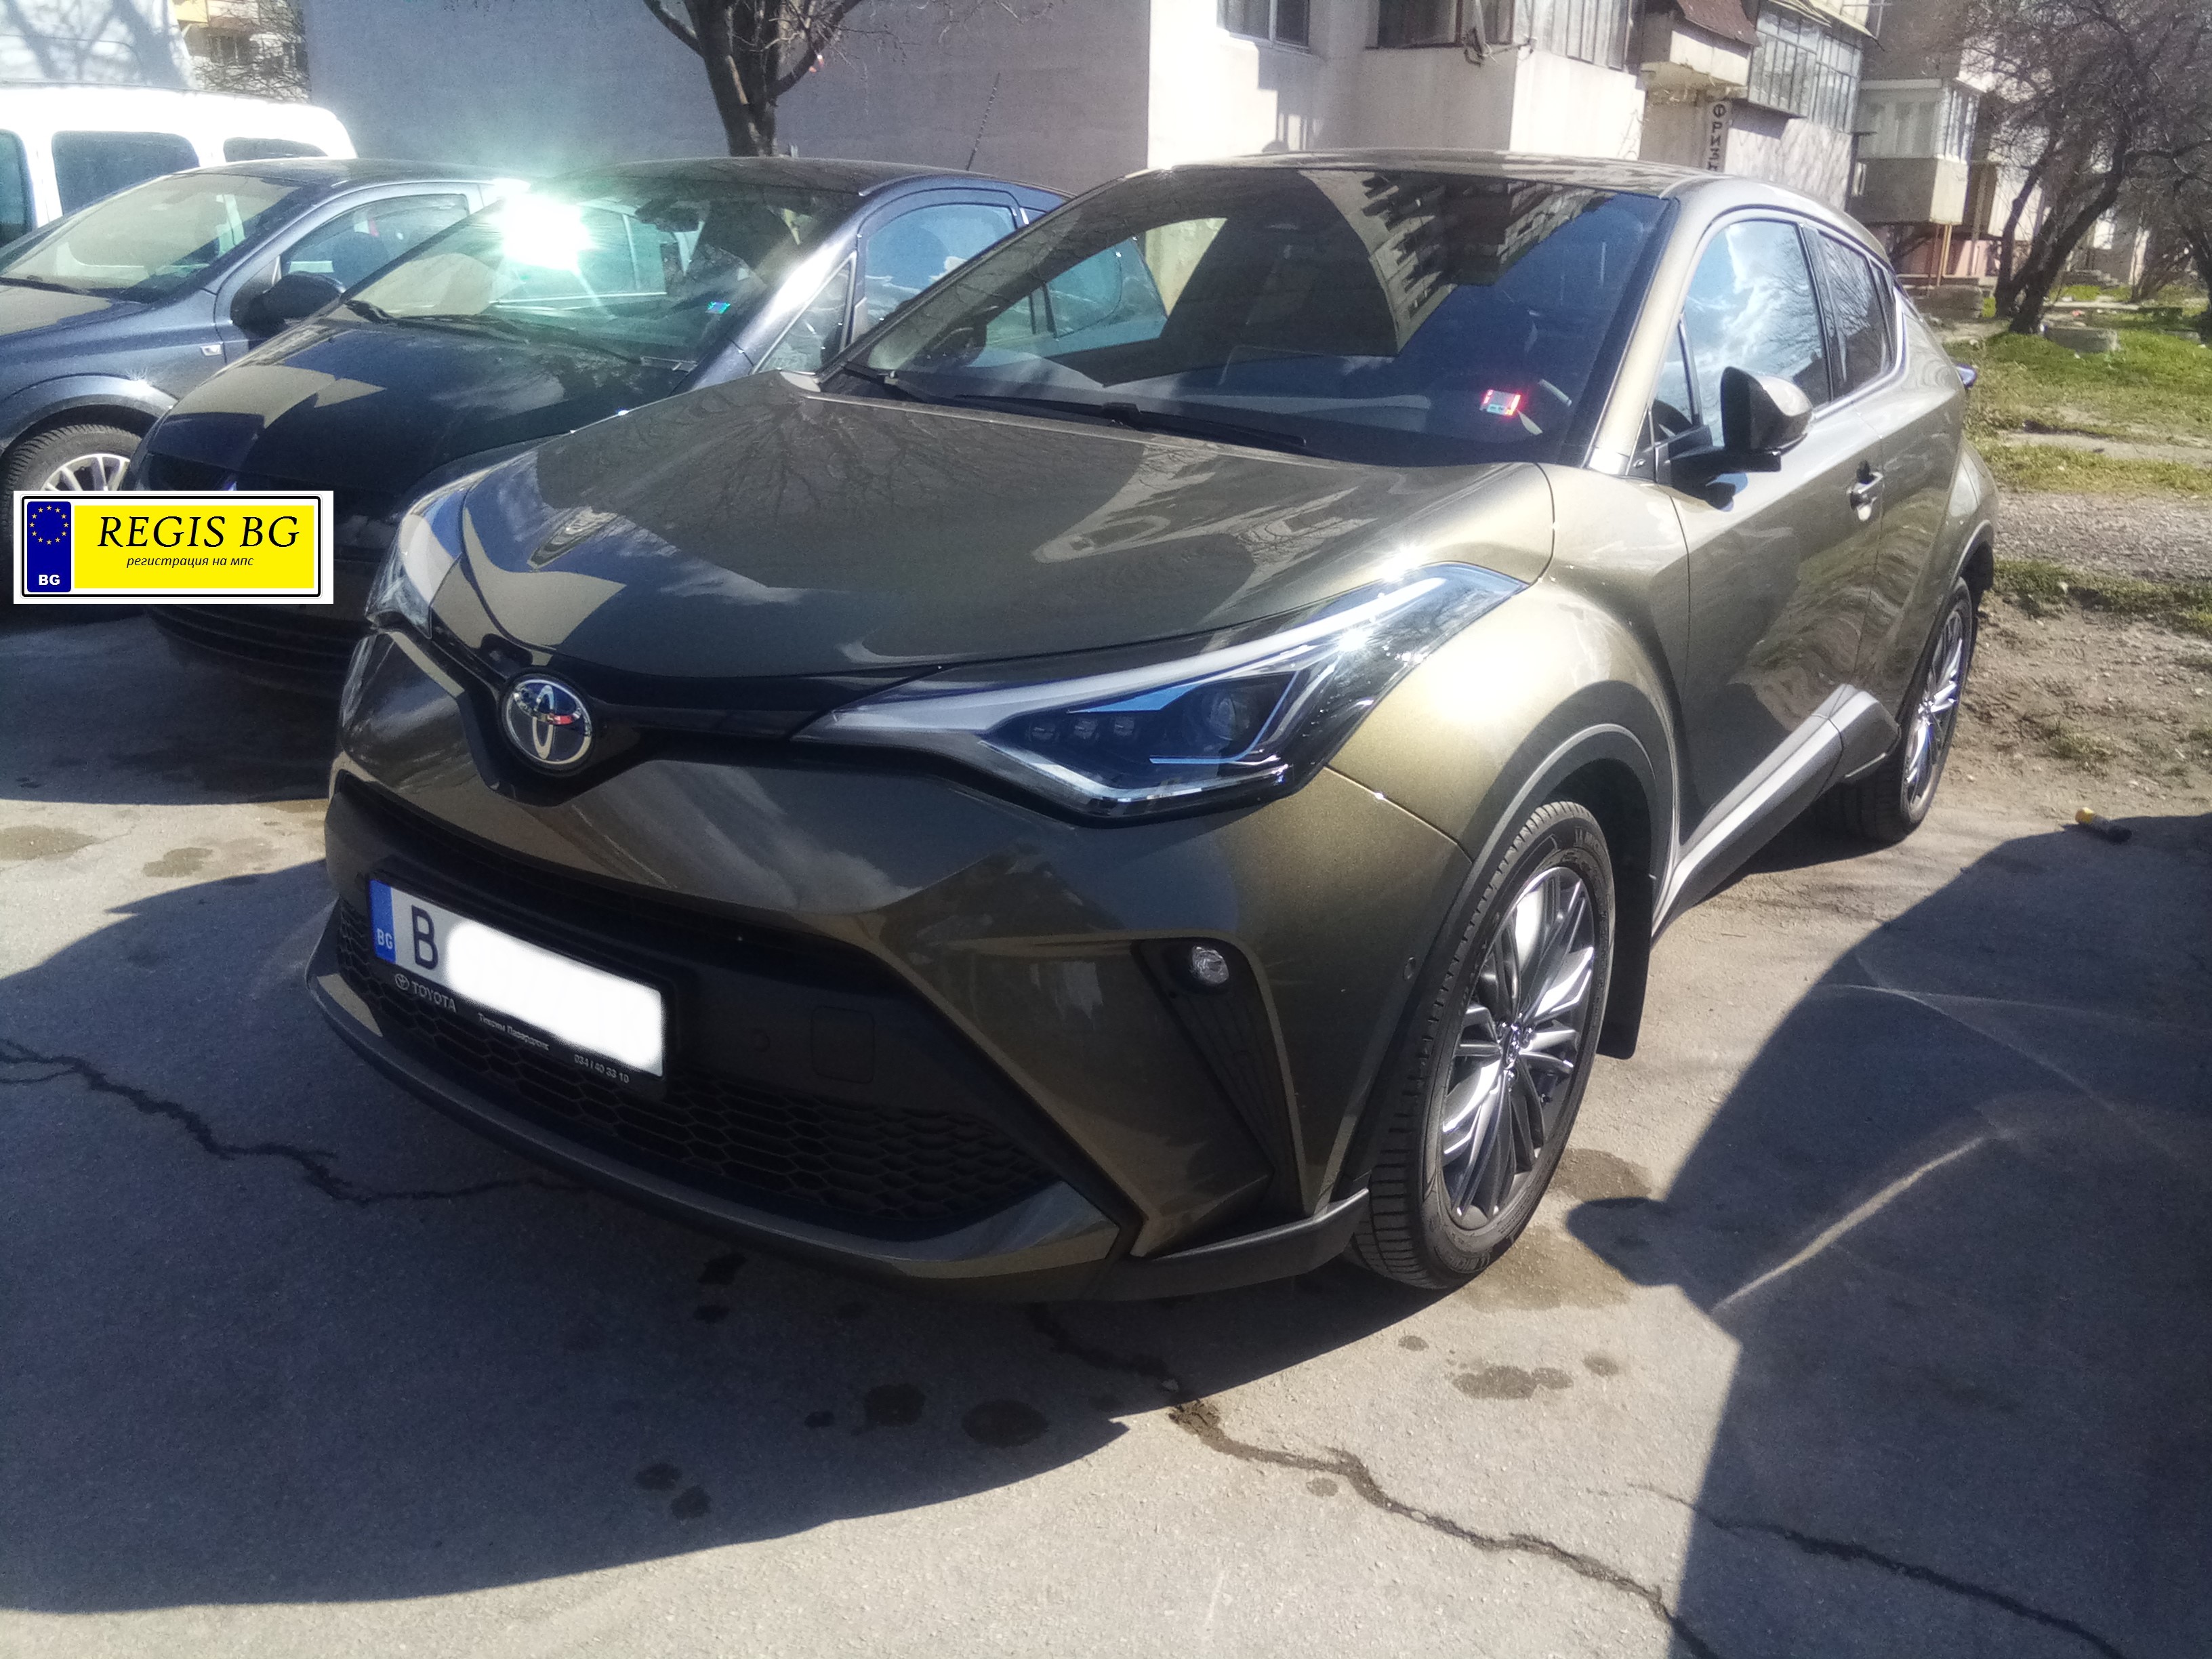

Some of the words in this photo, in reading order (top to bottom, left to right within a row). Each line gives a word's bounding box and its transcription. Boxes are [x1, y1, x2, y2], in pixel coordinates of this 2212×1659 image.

[376, 927, 394, 950] BG
[411, 981, 457, 1013] TOYOTA
[619, 1072, 630, 1084] 10
